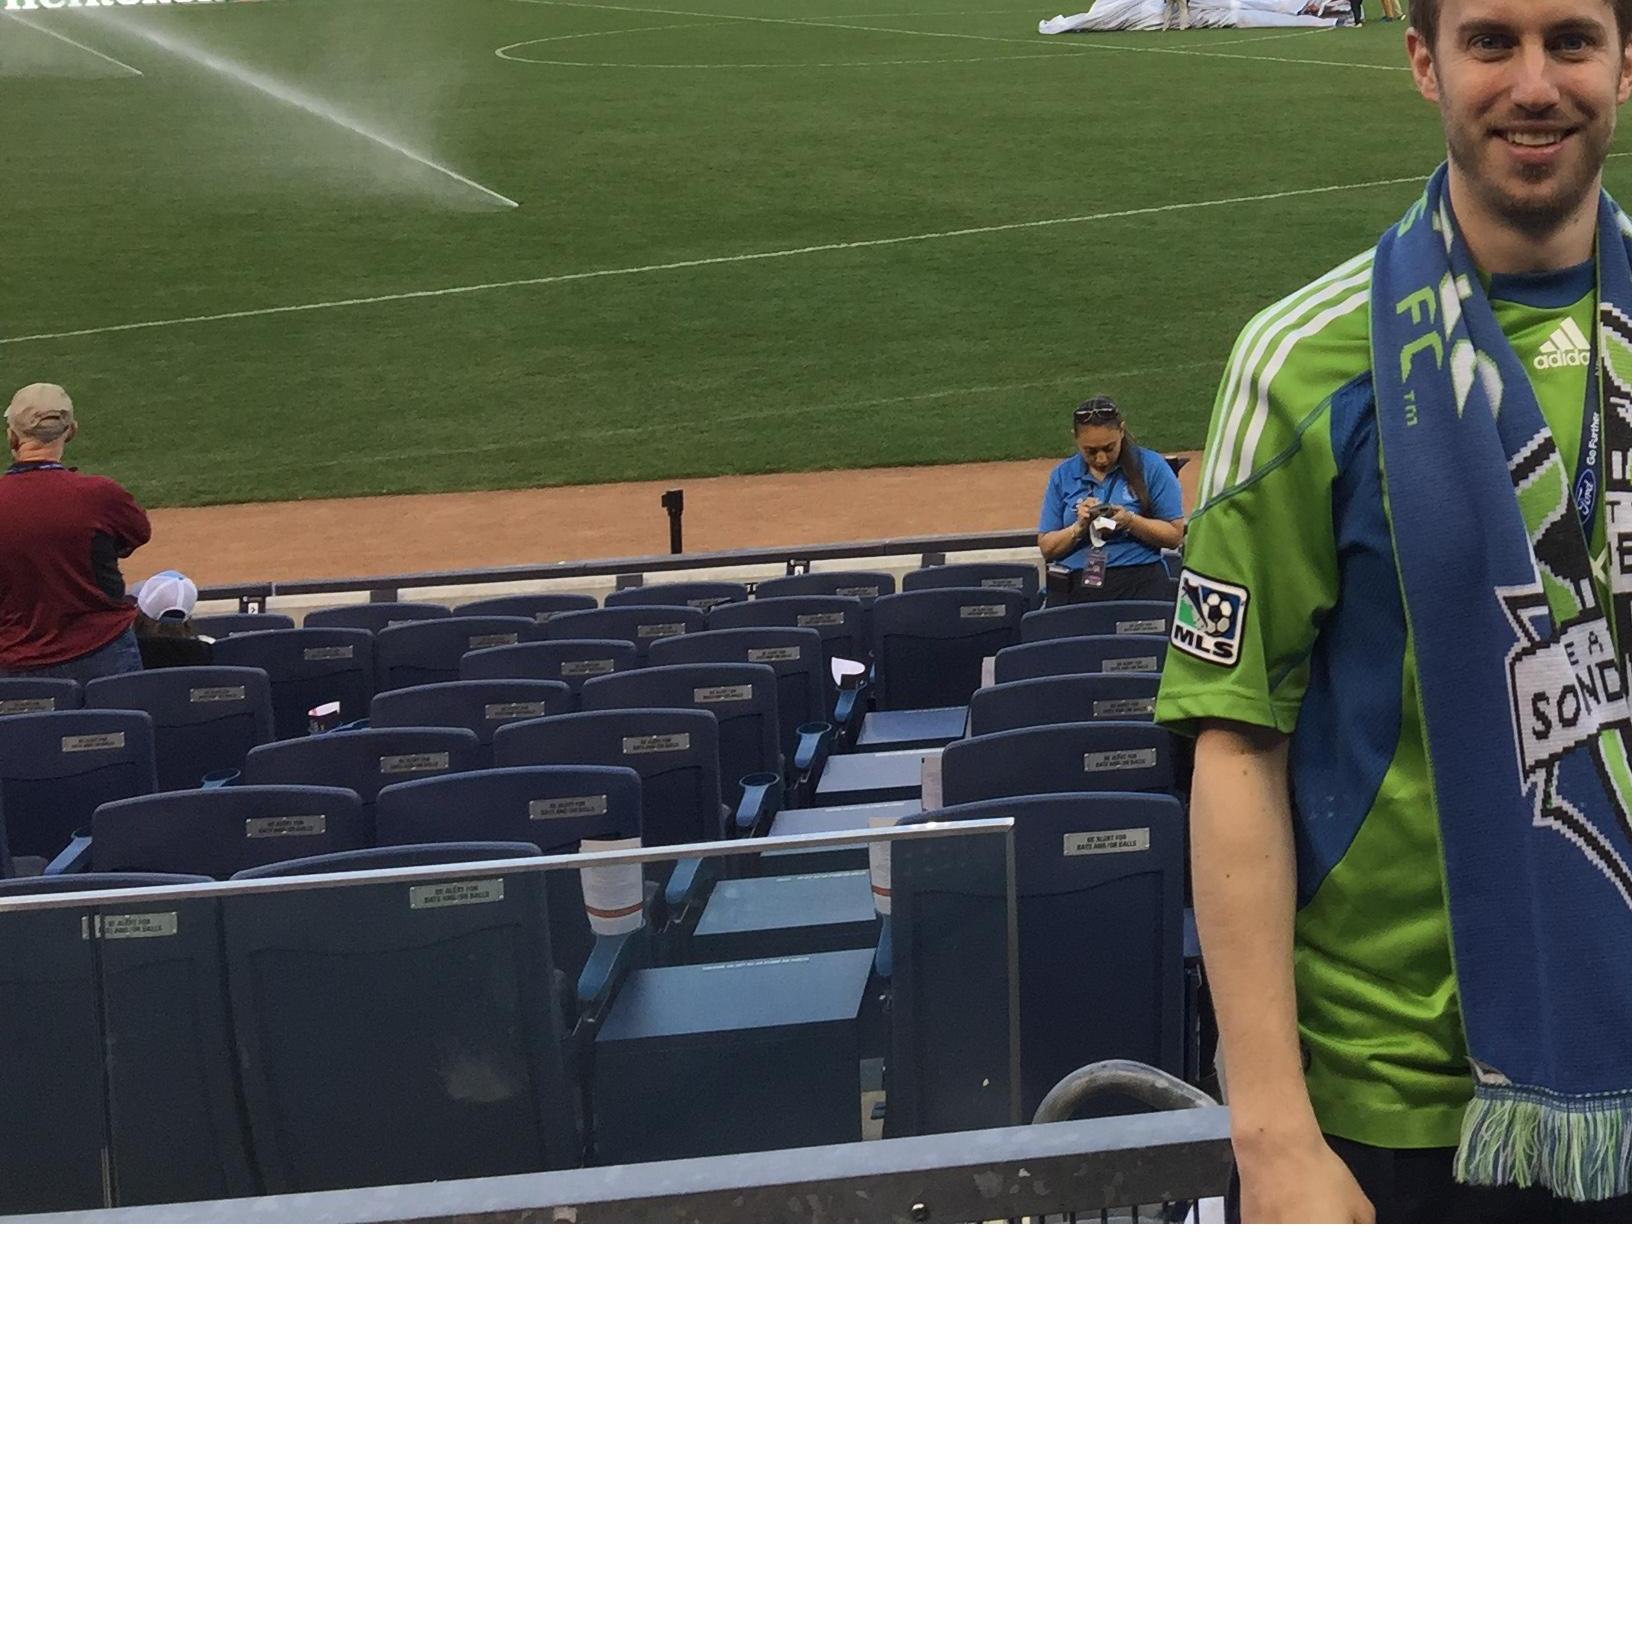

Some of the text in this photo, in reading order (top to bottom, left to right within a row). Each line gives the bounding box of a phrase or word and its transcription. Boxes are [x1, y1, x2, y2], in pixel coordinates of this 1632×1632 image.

[1533, 348, 1591, 369] adida
[1587, 411, 1600, 466] Go Further
[1577, 480, 1594, 516] Ford
[1173, 624, 1235, 659] MLS
[1531, 658, 1626, 741] SOND
